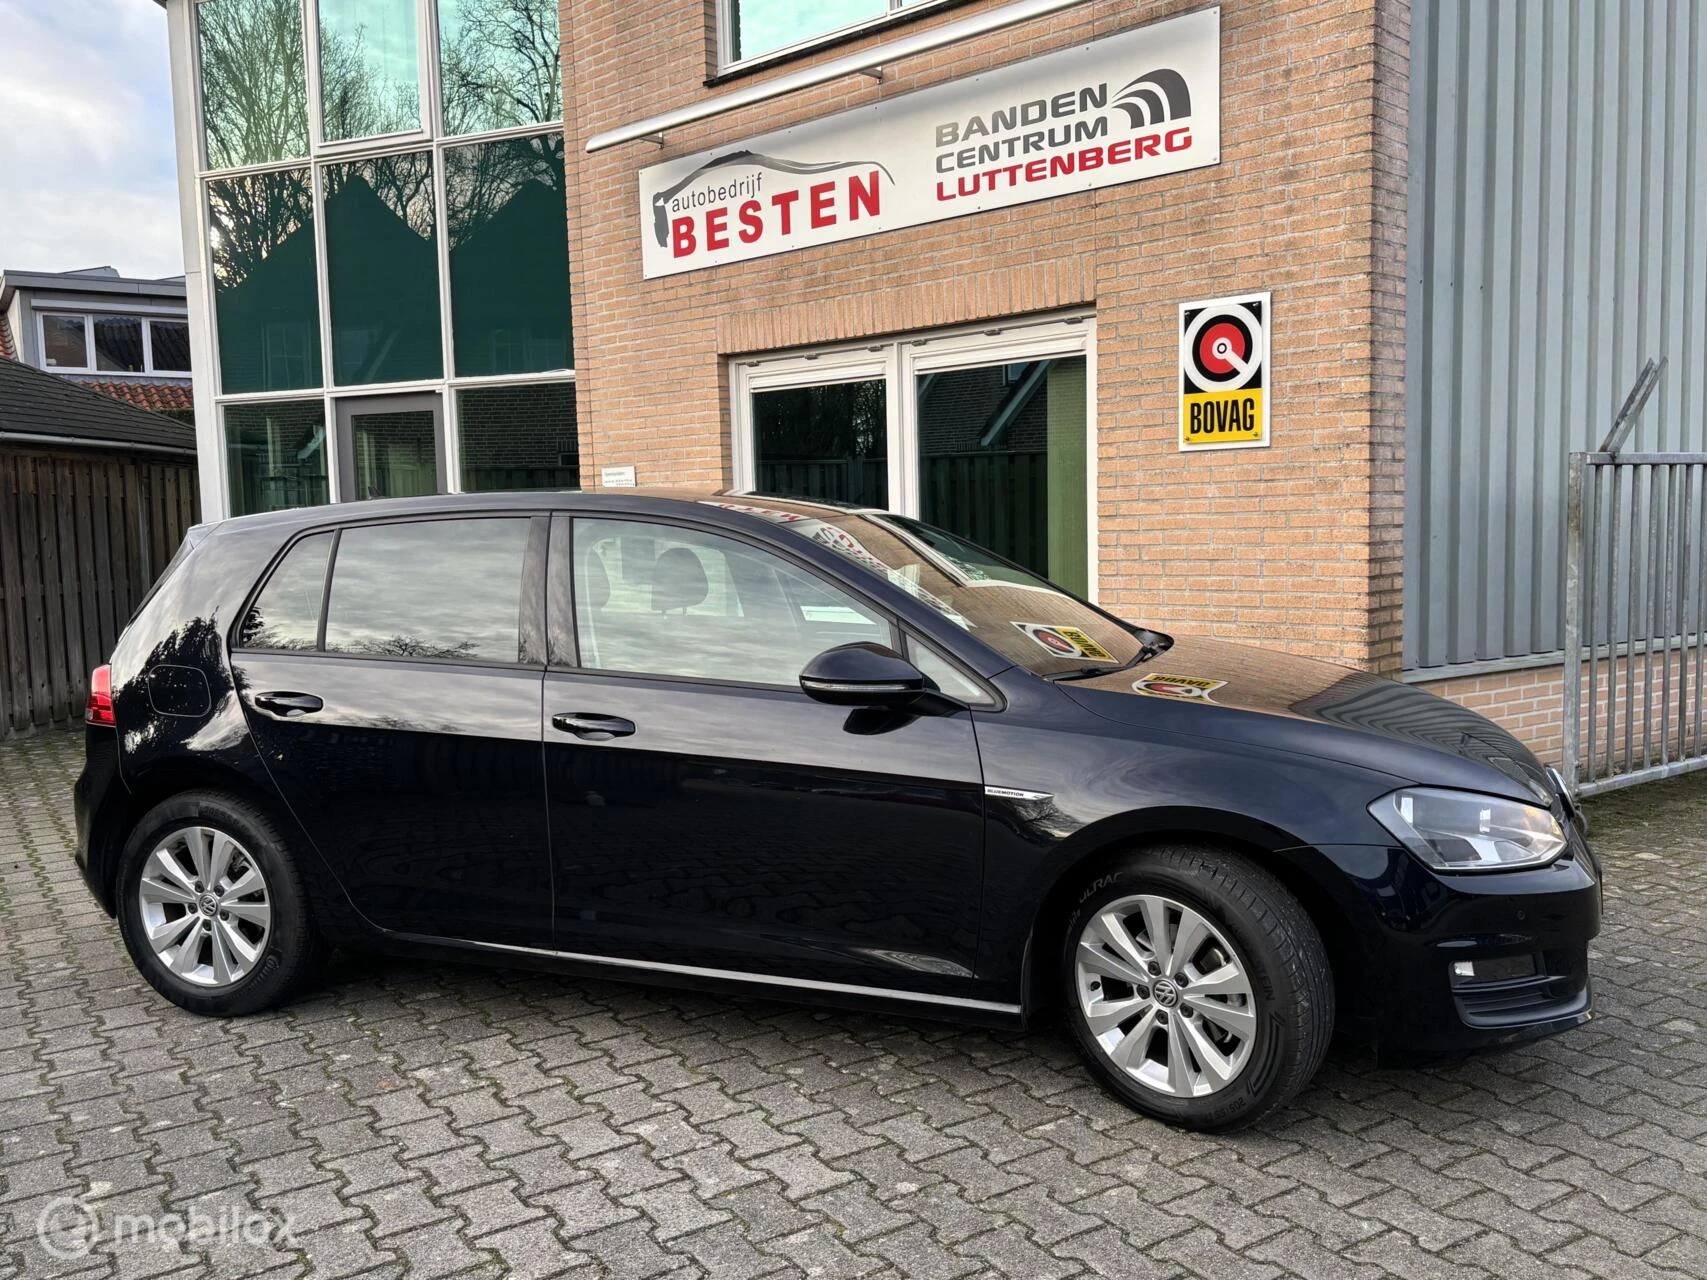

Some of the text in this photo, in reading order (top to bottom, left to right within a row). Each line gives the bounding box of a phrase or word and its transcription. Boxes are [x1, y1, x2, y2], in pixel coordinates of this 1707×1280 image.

[935, 115, 1109, 174] CENTRUM
[936, 83, 1108, 148] BANDEN
[671, 171, 763, 213] autobedrijf
[936, 126, 1193, 202] LUTTENBERG
[672, 171, 881, 259] BESTEN
[1190, 398, 1254, 434] BOVAG
[986, 788, 1025, 797] BLUEMOTION
